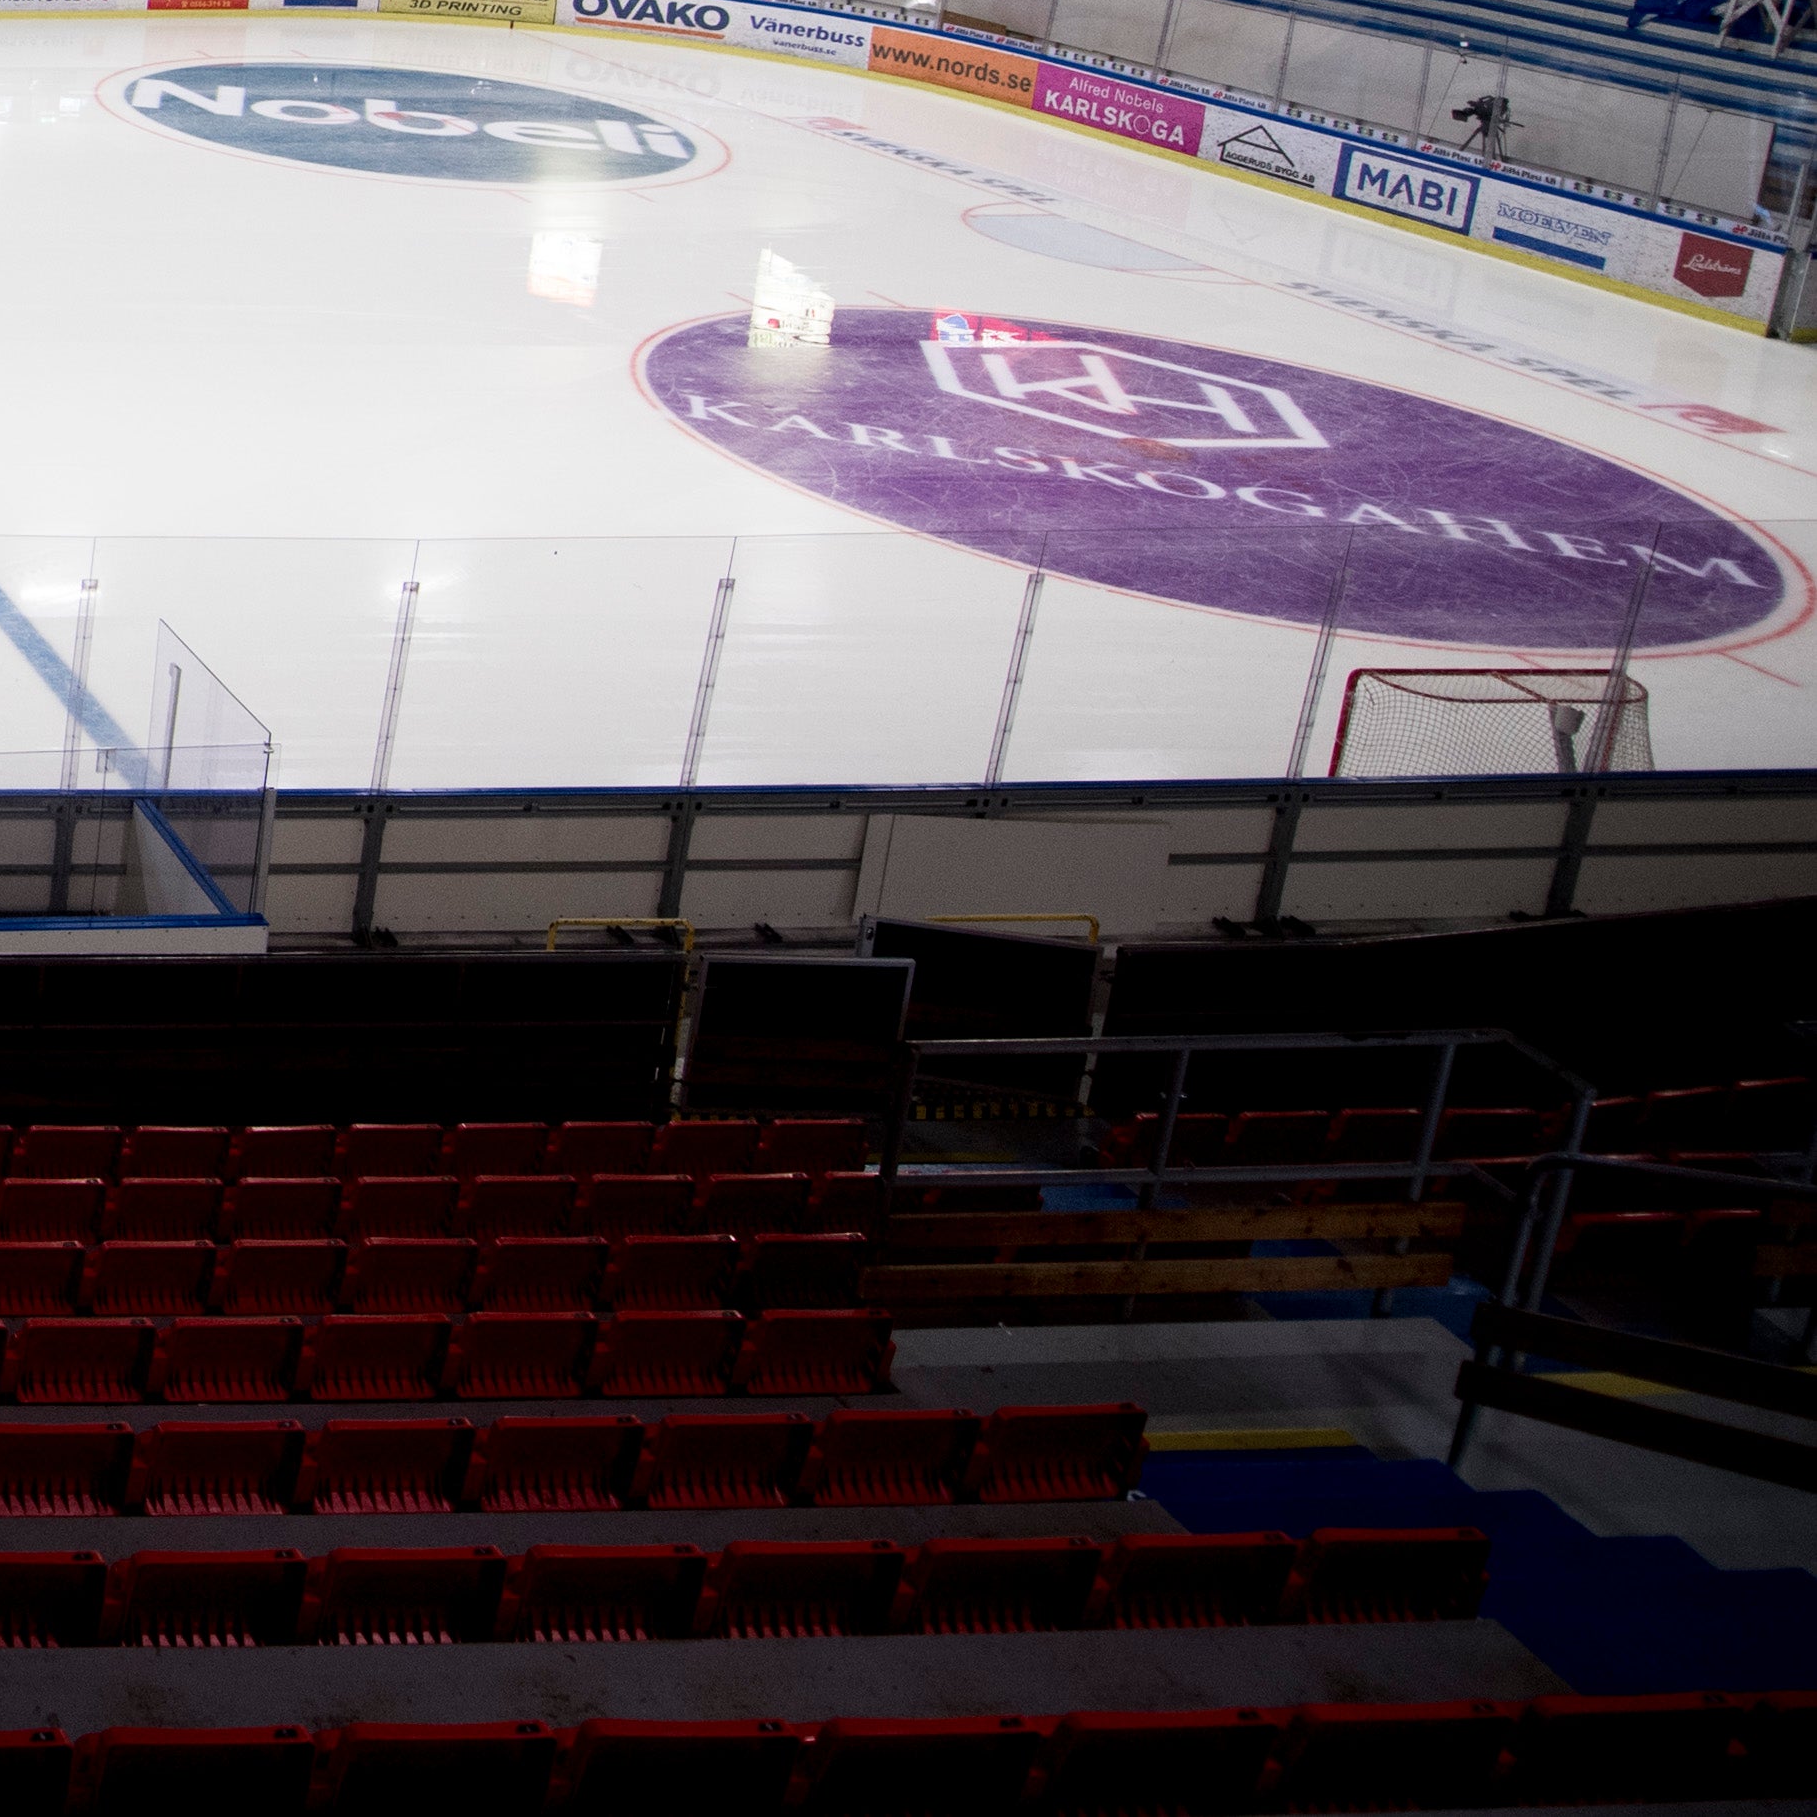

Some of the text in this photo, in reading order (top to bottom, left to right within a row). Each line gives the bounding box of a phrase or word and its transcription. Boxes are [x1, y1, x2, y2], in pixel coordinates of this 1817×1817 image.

[409, 0, 523, 16] 3D PRINTING
[750, 13, 866, 50] Vänerbuss
[872, 42, 1033, 94] www.nords.se
[131, 78, 693, 159] Nobeli
[1044, 88, 1185, 147] KARLSKOGA
[1068, 75, 1165, 115] Alfred Nobels
[833, 127, 1057, 204] SVENSKA SPEL
[1224, 149, 1316, 183] AGGERUDS BYGG AB
[1357, 162, 1459, 217] MABI
[1497, 202, 1613, 246] MOELVEN
[1286, 278, 1644, 402] SVENSKA SPEL
[681, 392, 1765, 589] KARLSKOGAHEM
